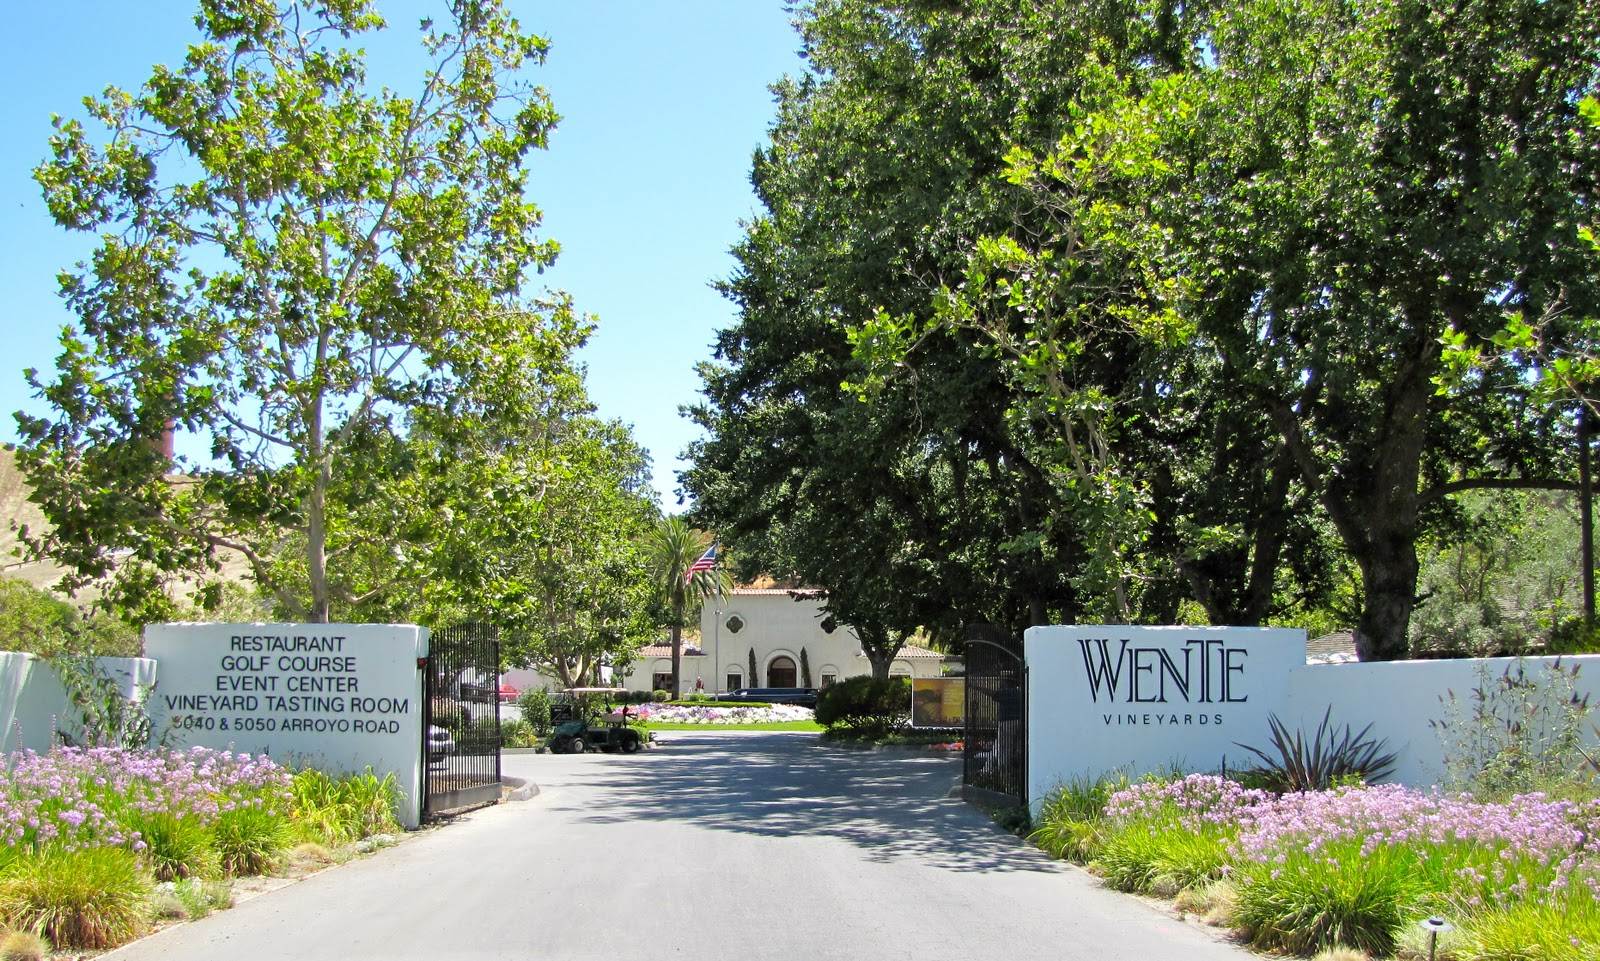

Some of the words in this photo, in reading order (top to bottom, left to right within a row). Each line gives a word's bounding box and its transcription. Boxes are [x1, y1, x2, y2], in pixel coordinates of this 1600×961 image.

[230, 635, 346, 652] RESTAURANT
[221, 655, 270, 671] GOLF
[277, 656, 357, 672] COURSE
[216, 676, 279, 691] EVENT
[286, 676, 358, 692] CENTER
[166, 695, 258, 711] VINEYARD
[265, 696, 344, 712] TASTING
[350, 698, 409, 714] ROOM
[219, 718, 229, 731] &
[234, 717, 276, 731] 5050
[281, 718, 350, 732] ARROYO
[353, 720, 400, 734] ROAD
[1103, 713, 1223, 725] VINEYARDS
